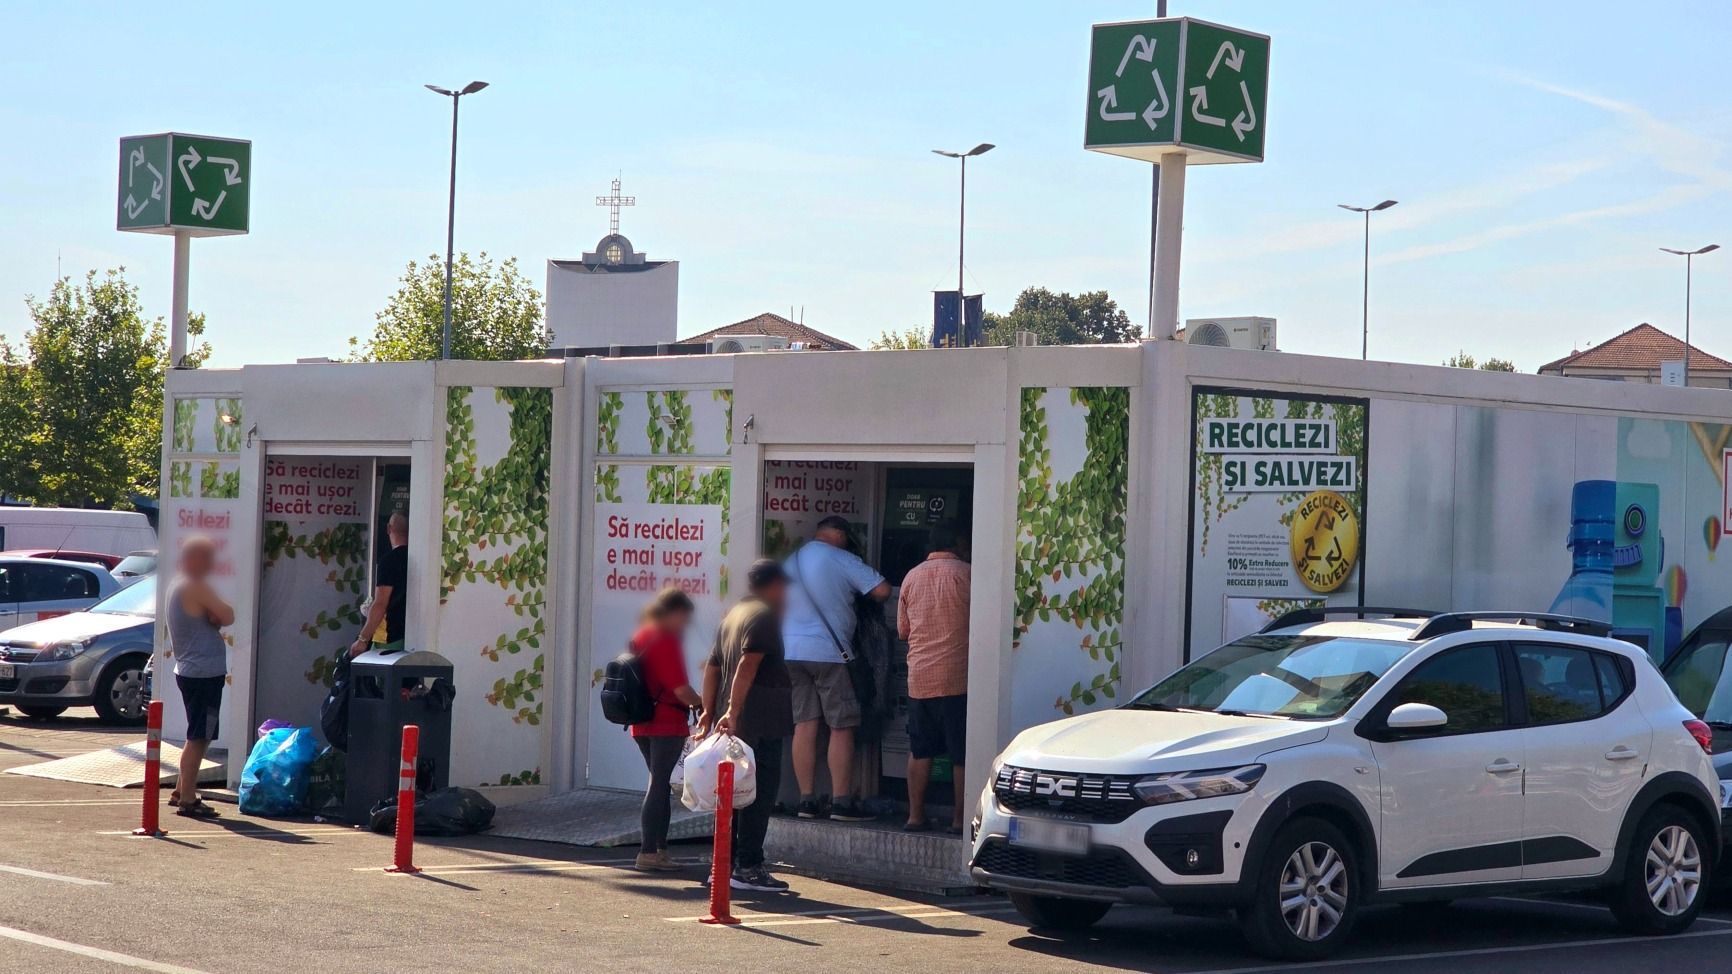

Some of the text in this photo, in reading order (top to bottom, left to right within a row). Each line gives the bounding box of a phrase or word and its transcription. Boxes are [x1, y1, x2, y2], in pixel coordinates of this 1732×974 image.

[1209, 422, 1330, 449] RECICLEZI
[292, 464, 360, 480] reciclezi
[1224, 460, 1351, 491] ȘI SALVEZI
[279, 481, 310, 496] mai
[317, 484, 354, 502] ușor
[775, 473, 807, 490] mai
[815, 478, 853, 497] ușor
[265, 499, 361, 516] decât crezi.
[814, 499, 860, 515] crezi.
[1300, 495, 1349, 522] RECICLEZI
[608, 515, 704, 541] Să reciclezi
[607, 544, 702, 574] e mai ușor
[1227, 558, 1248, 570] 10%
[606, 567, 657, 591] decât
[1227, 579, 1256, 587] RECICLEZI
[1264, 579, 1289, 587] SALVEZI
[1308, 558, 1350, 586] SALVEZI
